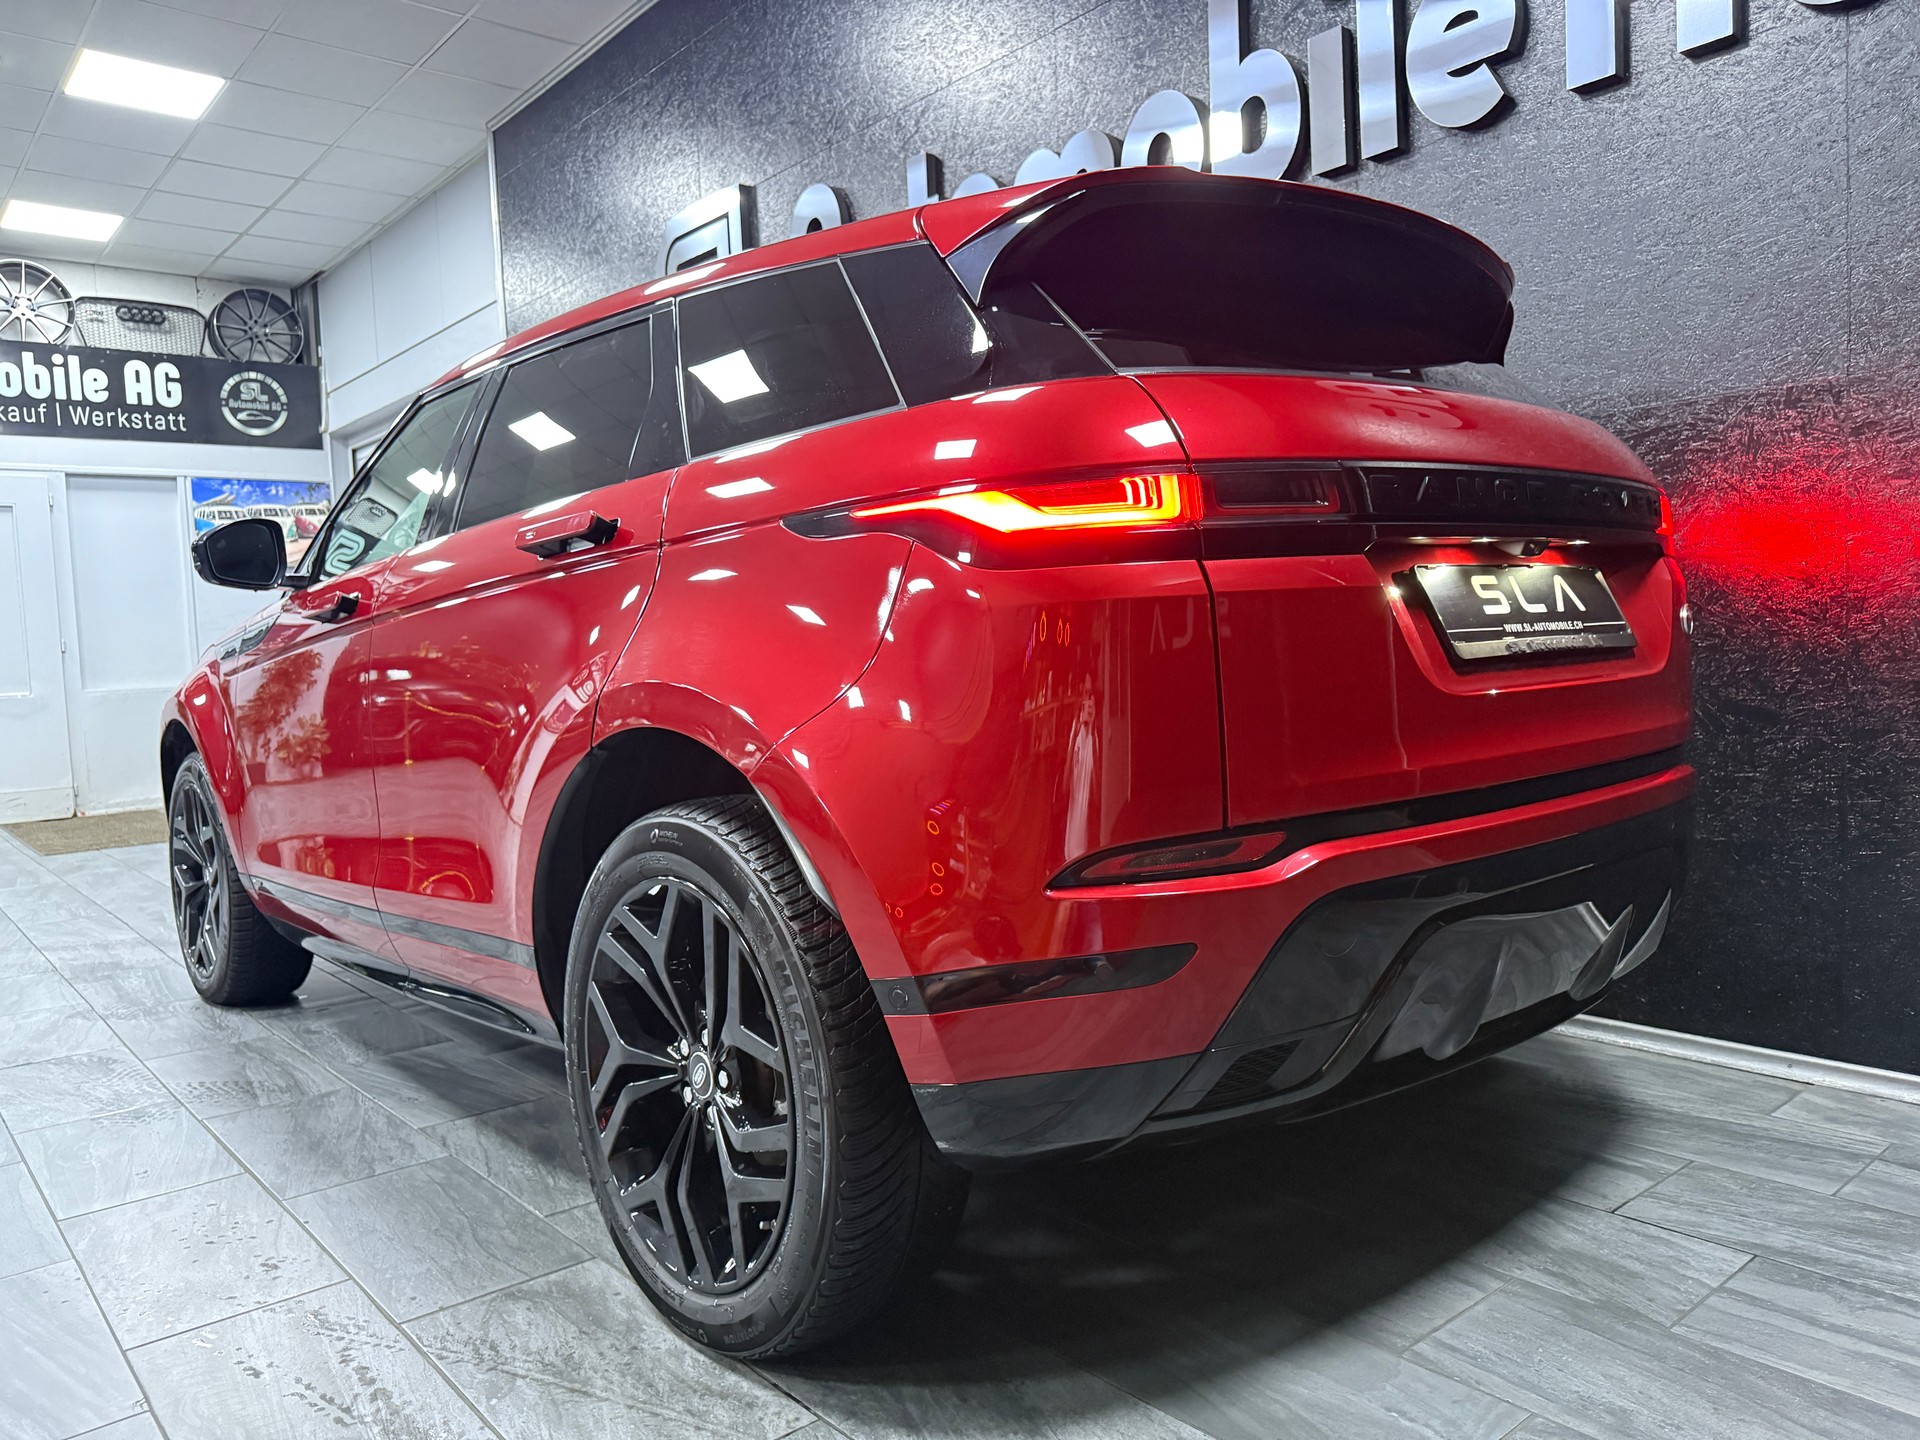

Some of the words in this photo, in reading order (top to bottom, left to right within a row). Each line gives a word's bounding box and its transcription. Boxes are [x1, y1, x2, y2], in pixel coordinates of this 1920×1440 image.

[123, 359, 183, 408] AG
[240, 382, 269, 401] SL
[68, 405, 187, 432] Werkstatt
[1503, 620, 1584, 633] WWW.SL-AUTOMOBILE.CH
